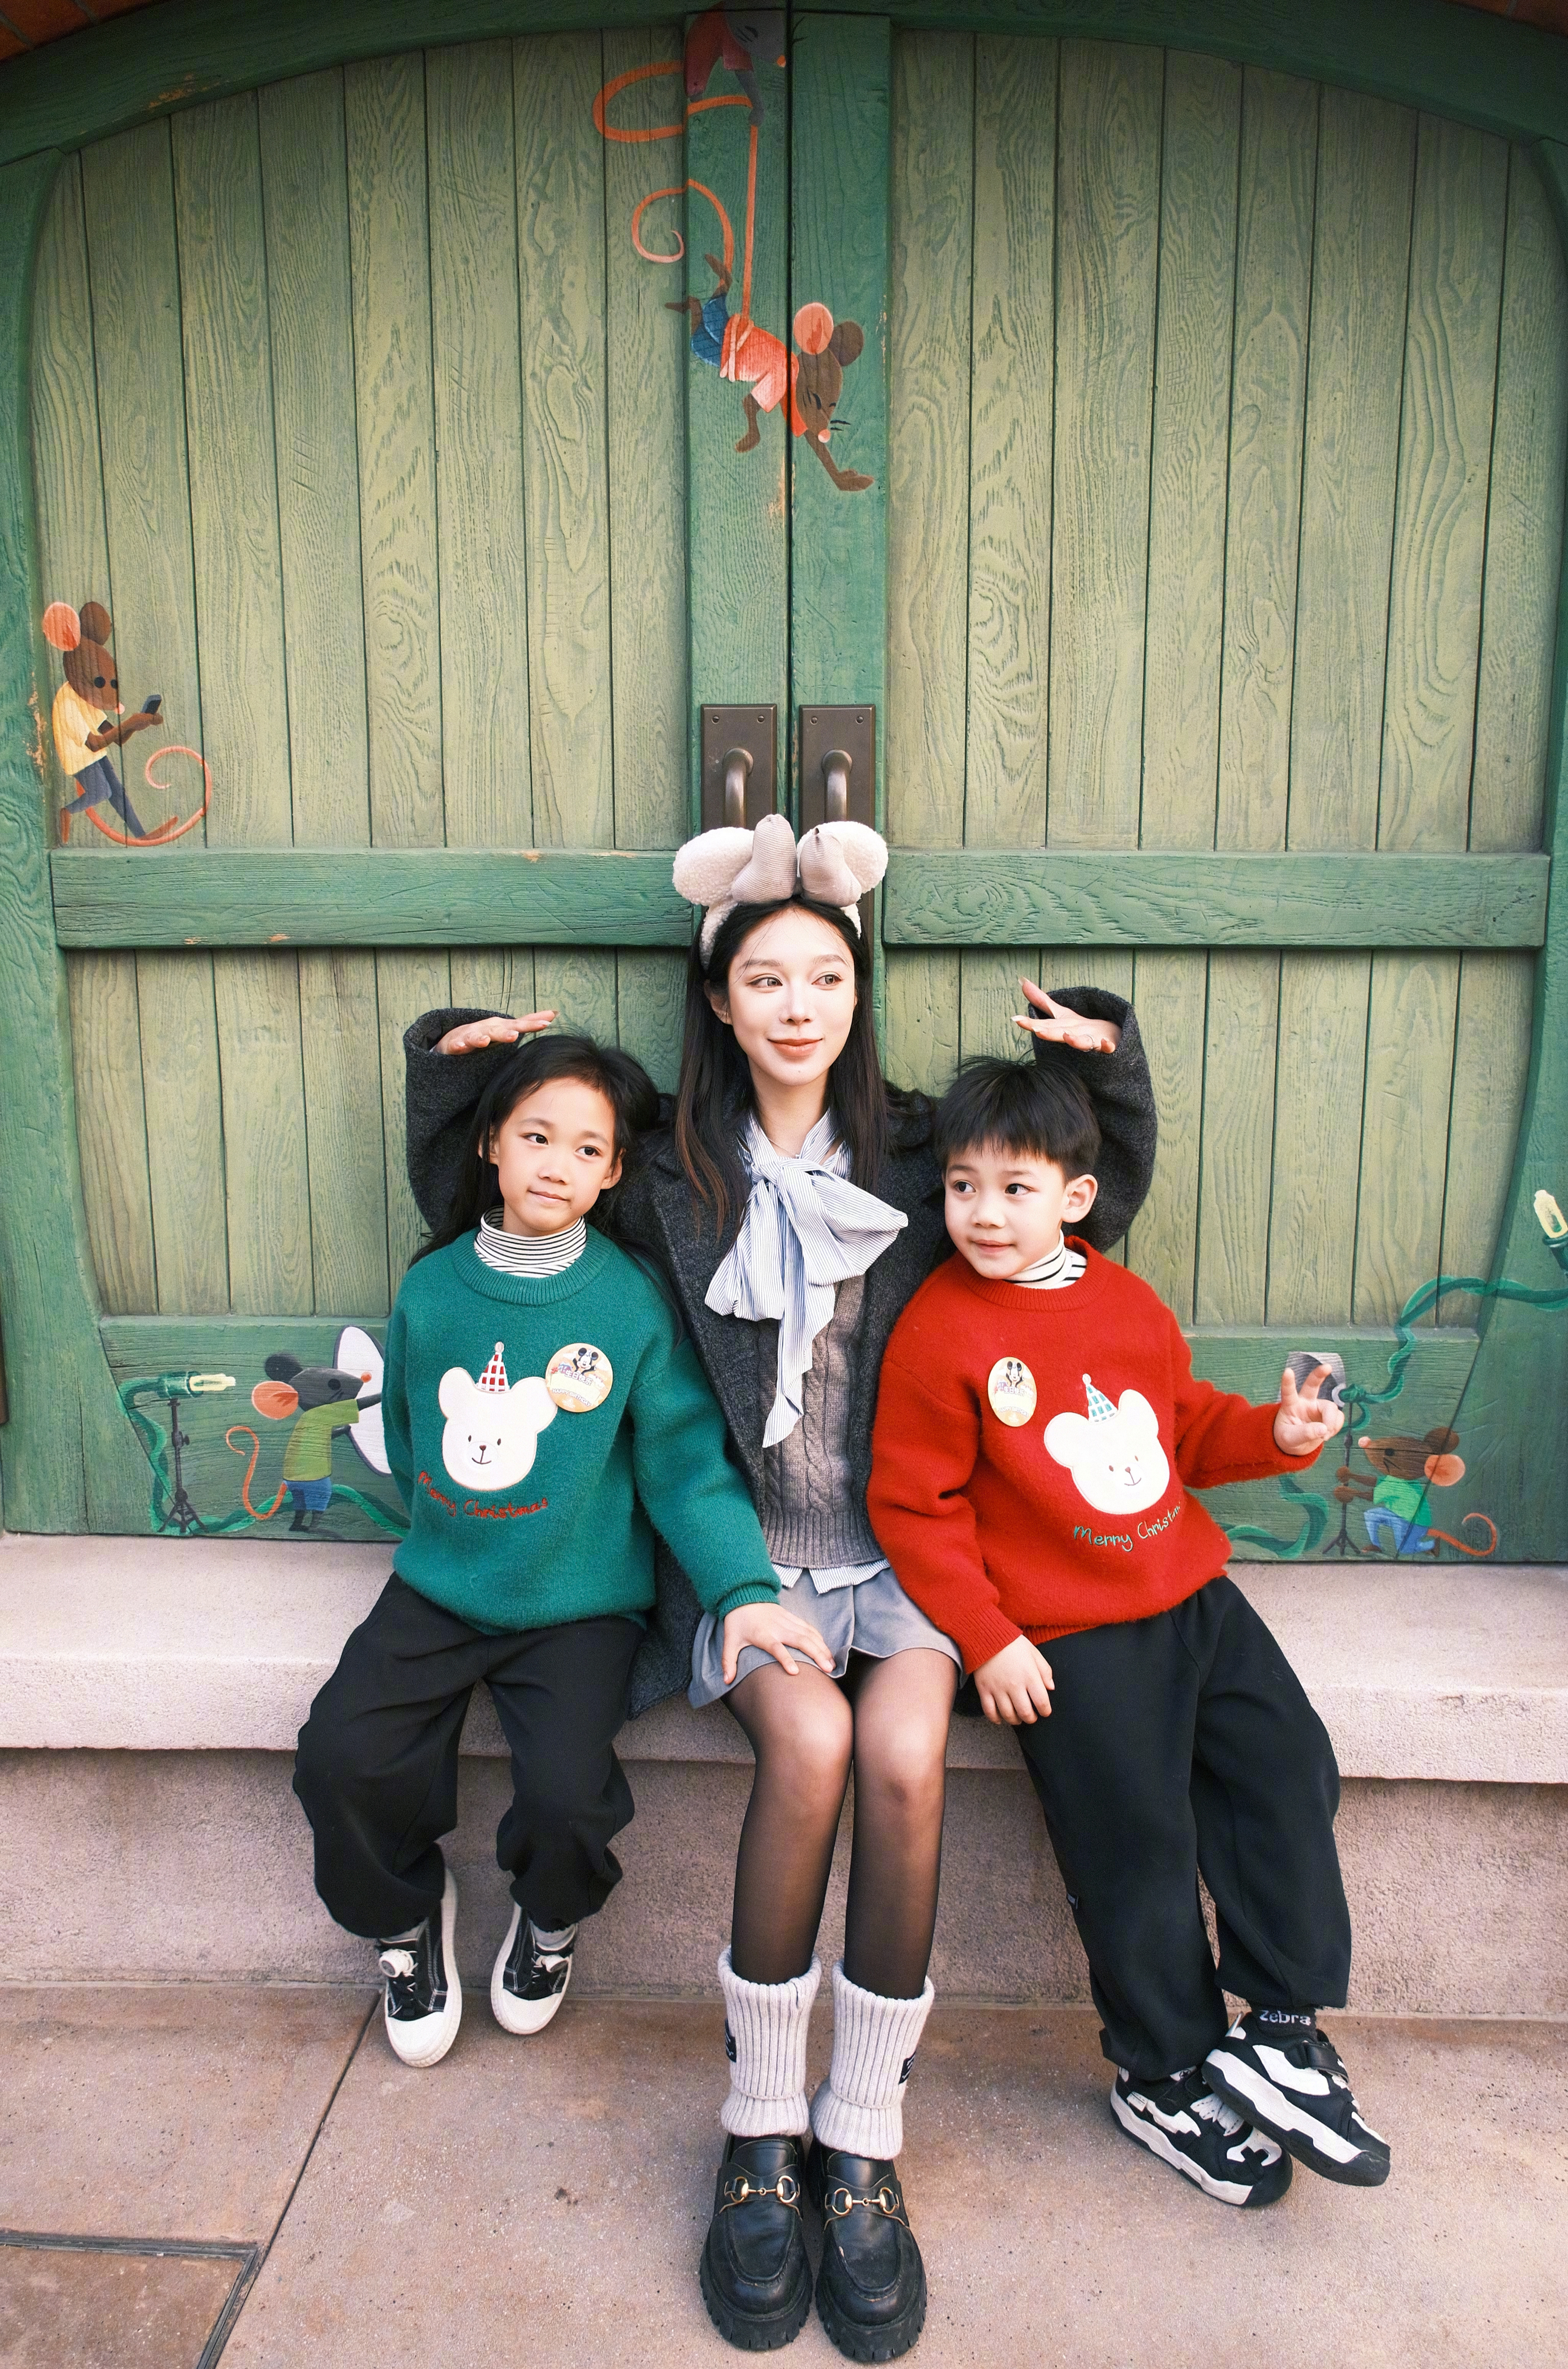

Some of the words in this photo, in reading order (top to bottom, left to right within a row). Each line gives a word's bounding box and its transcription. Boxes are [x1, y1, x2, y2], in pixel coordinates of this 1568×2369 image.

[565, 1369, 593, 1385] 生日快乐
[569, 1391, 591, 1407] BIRTHDAY
[1003, 1386, 1025, 1397] 生日快乐
[1012, 1407, 1029, 1417] BIRTHDAY
[418, 1471, 456, 1517] Merry
[464, 1498, 548, 1518] Christmas
[1074, 1525, 1133, 1552] Merry
